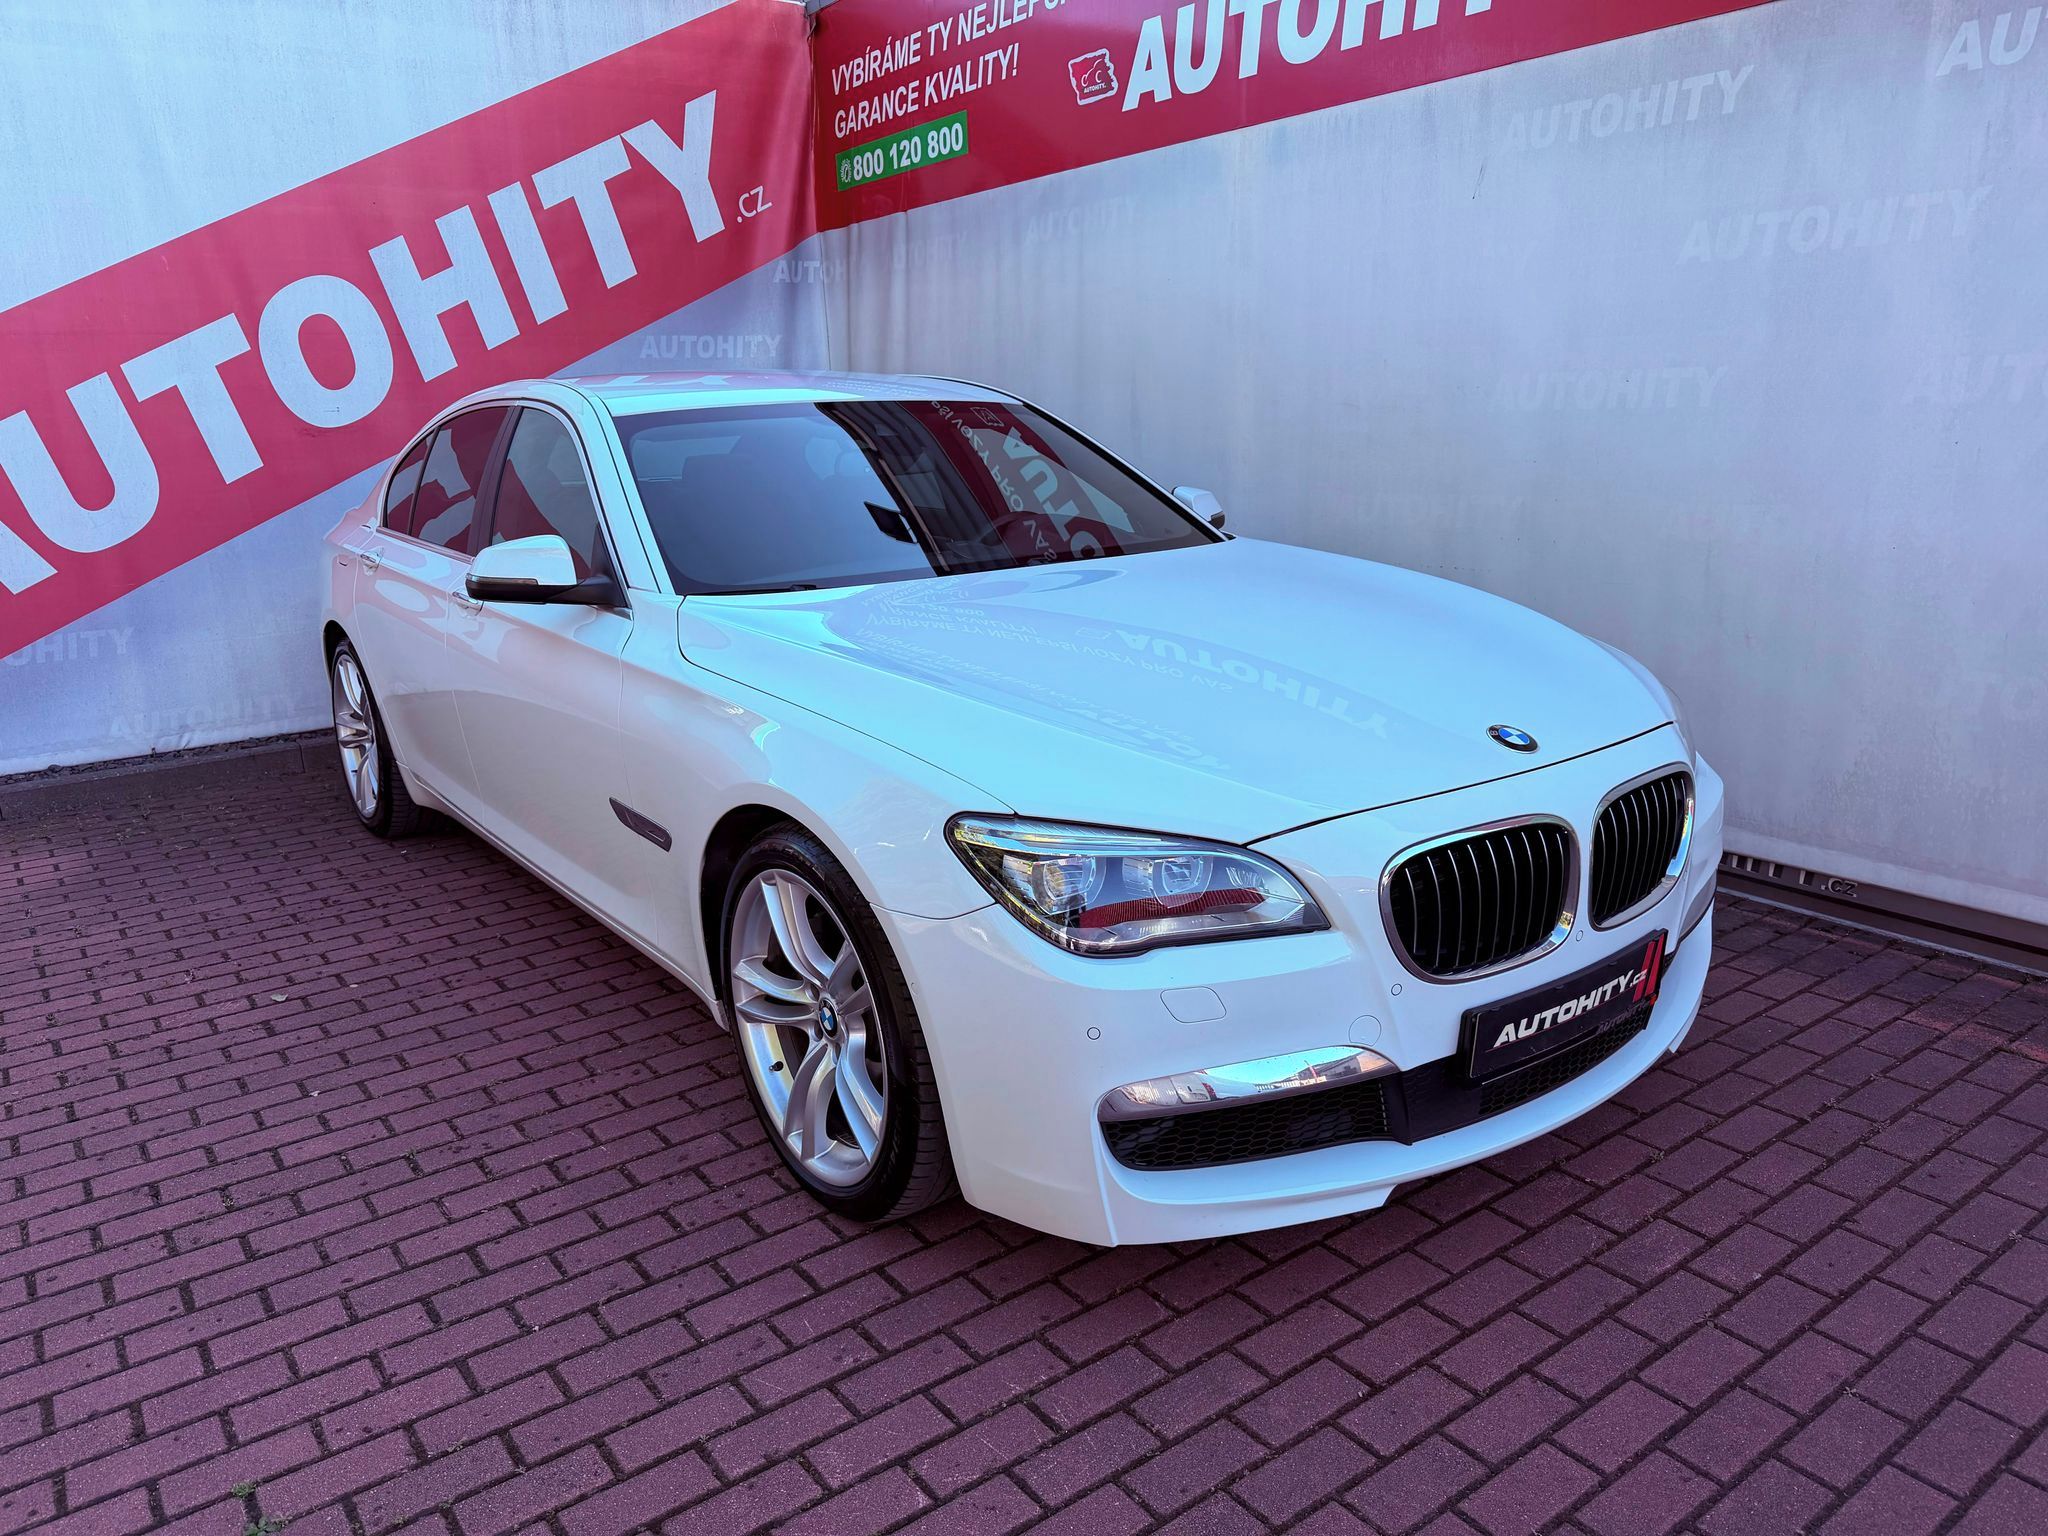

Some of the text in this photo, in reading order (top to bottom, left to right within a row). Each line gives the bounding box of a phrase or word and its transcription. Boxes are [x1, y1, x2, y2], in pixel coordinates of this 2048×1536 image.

[832, 31, 922, 96] VYBÍRÁME
[927, 17, 953, 57] TY
[1935, 6, 2048, 77] AU
[834, 42, 1020, 139] GARANCE KVALITY!
[853, 122, 963, 181] 800 120 800
[639, 335, 782, 359] AUTOHITY
